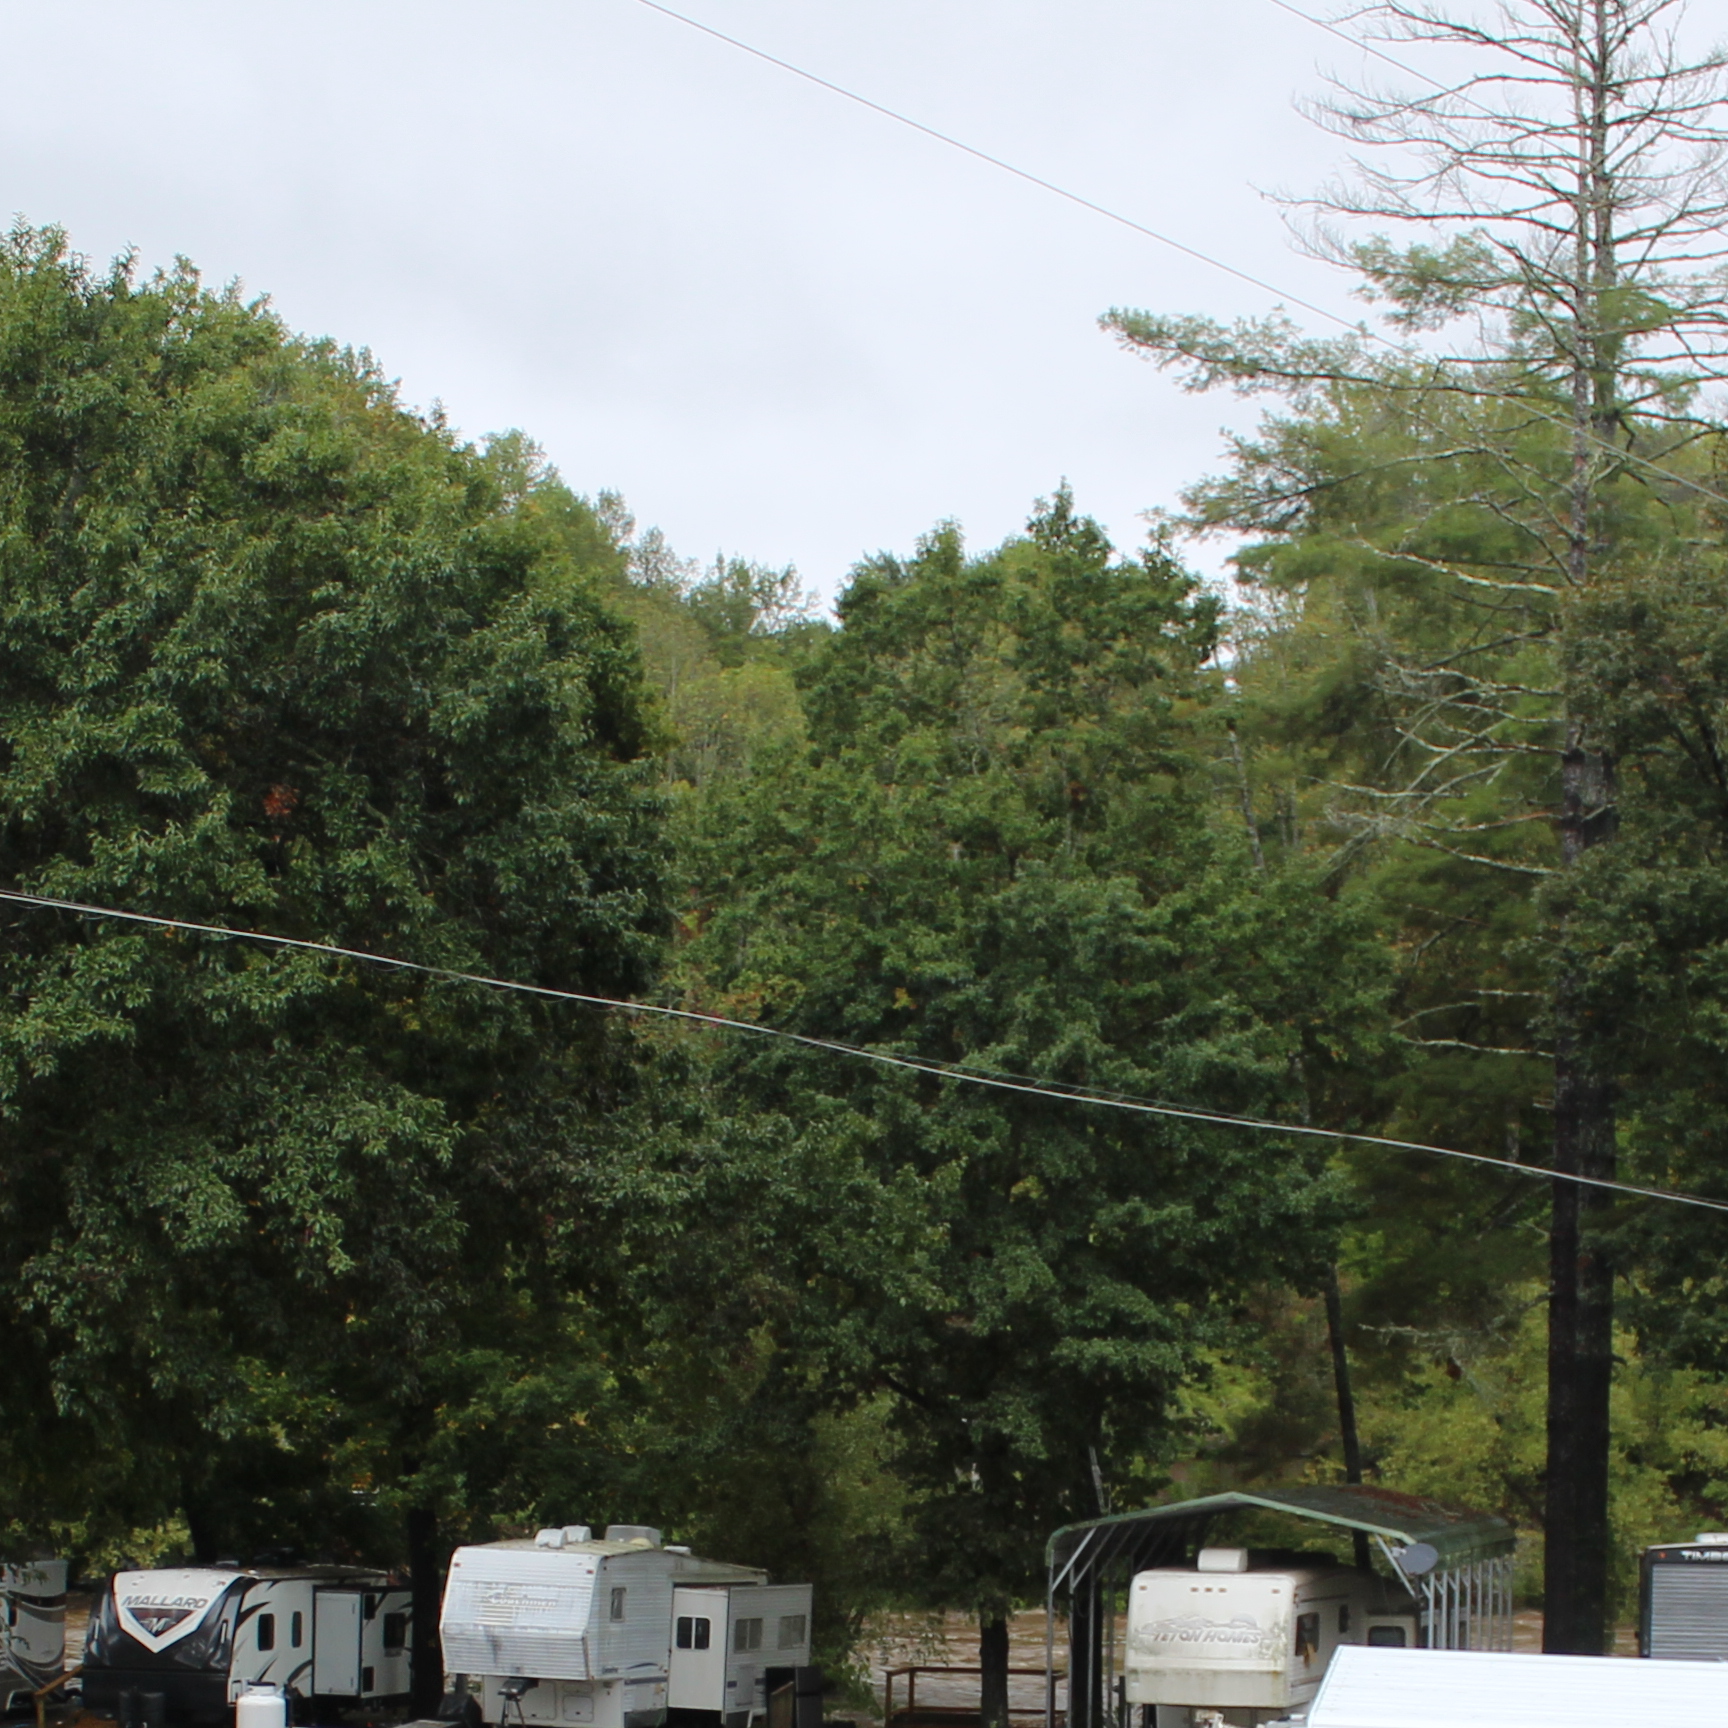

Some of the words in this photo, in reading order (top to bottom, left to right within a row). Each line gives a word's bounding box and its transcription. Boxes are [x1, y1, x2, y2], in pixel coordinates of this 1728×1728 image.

[121, 1594, 210, 1609] MALLARD
[1153, 1629, 1200, 1643] TETON
[1202, 1629, 1262, 1644] HOMES
